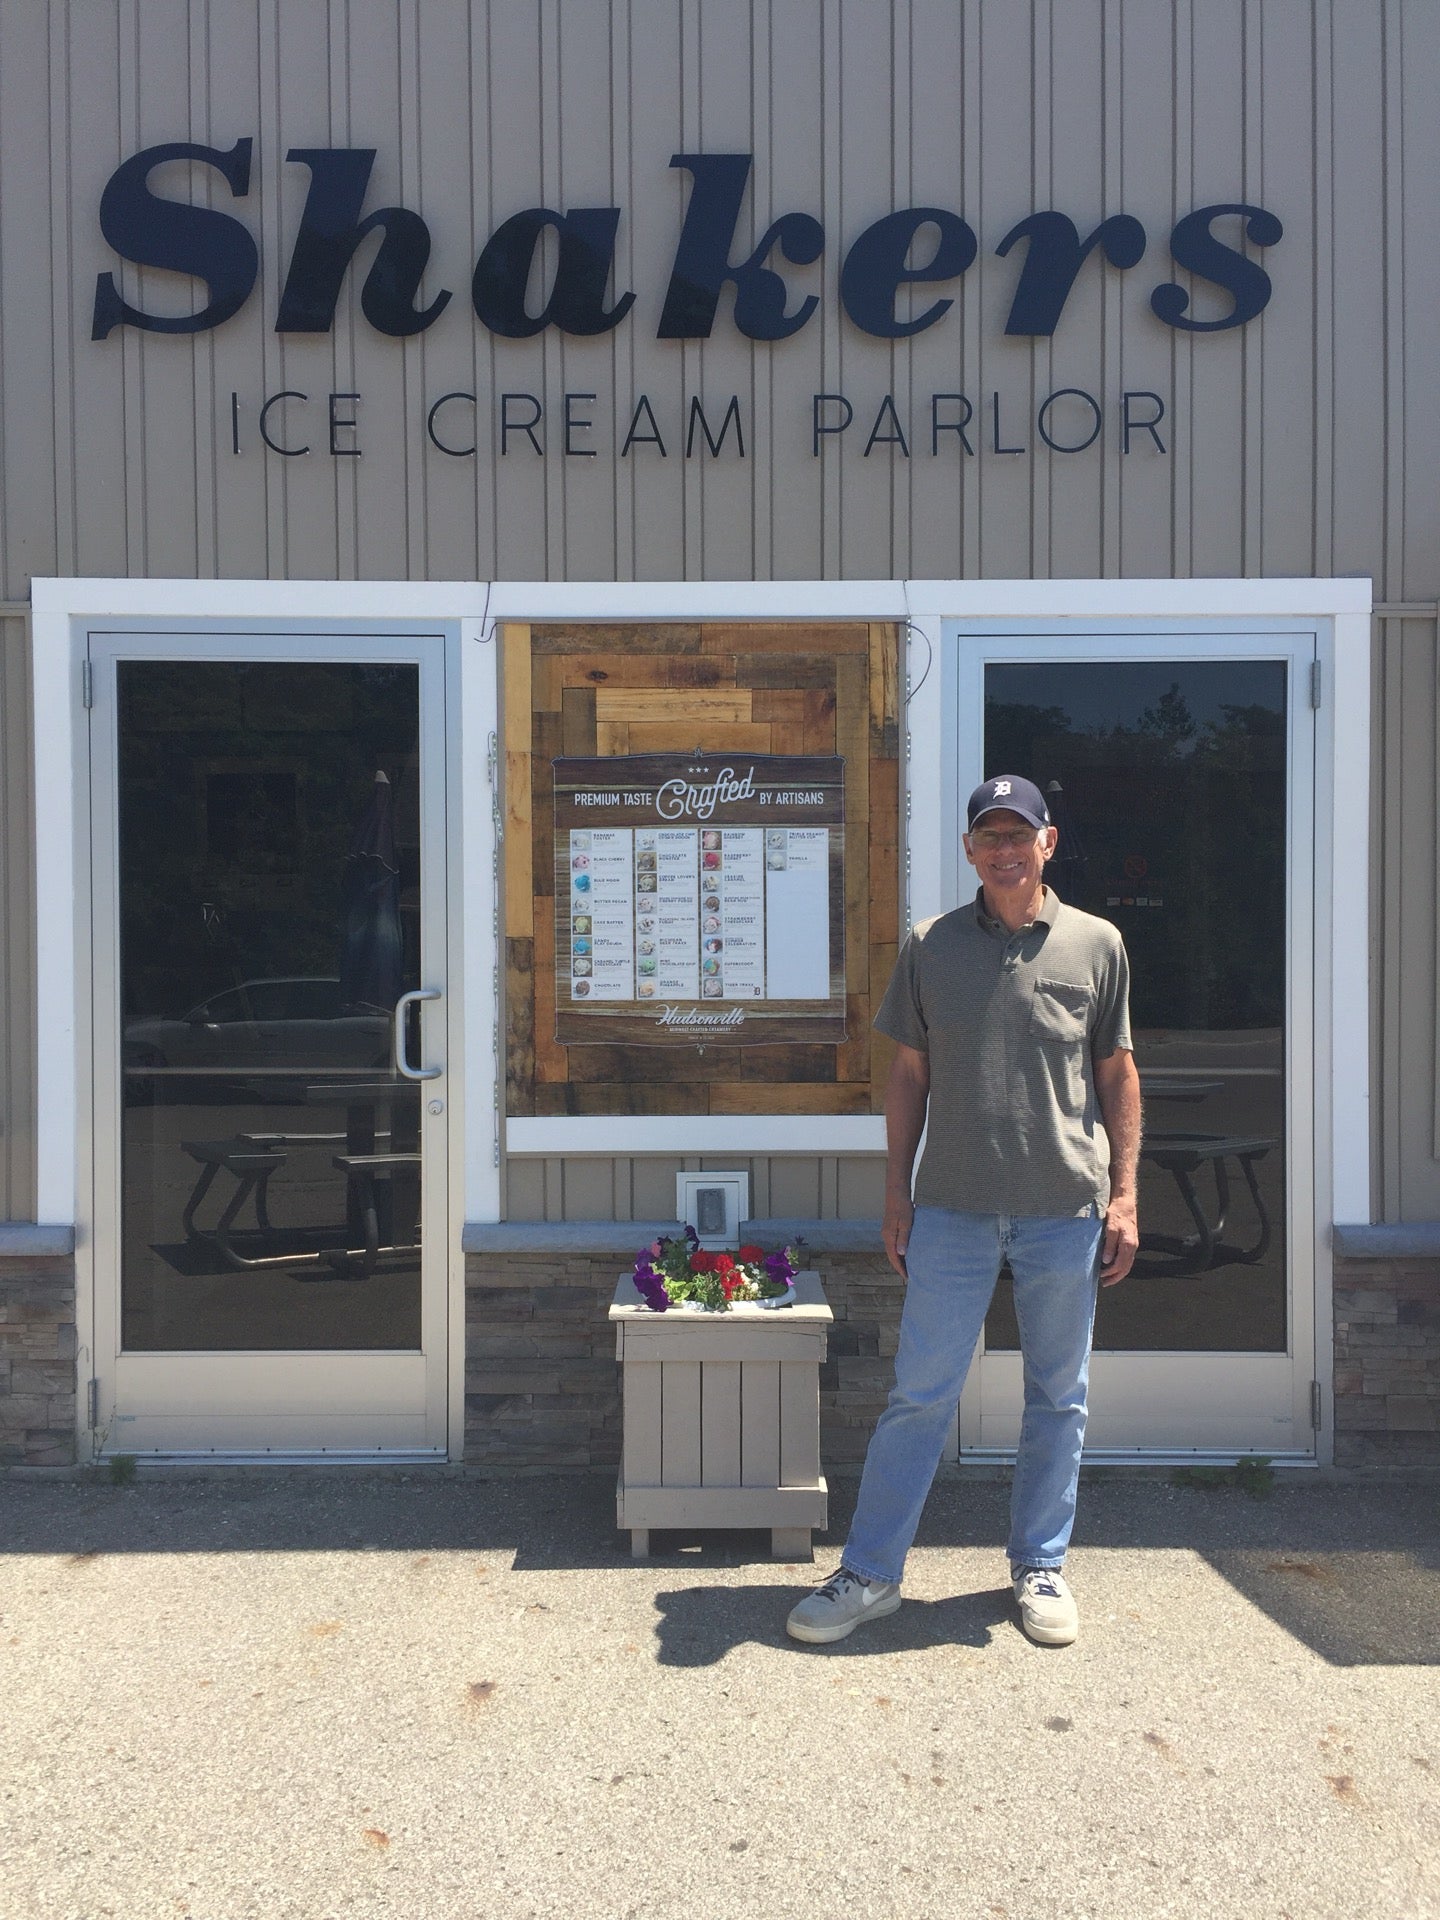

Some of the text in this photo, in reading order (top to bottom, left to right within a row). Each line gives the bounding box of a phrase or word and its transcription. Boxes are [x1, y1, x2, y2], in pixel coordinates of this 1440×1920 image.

[91, 137, 1283, 341] Shakers
[231, 388, 1167, 459] ICE CREAM PARLOR
[574, 766, 824, 820] PREMIUM TASTE Crafted BY ARTISANS
[655, 1003, 745, 1026] Hudsonville
